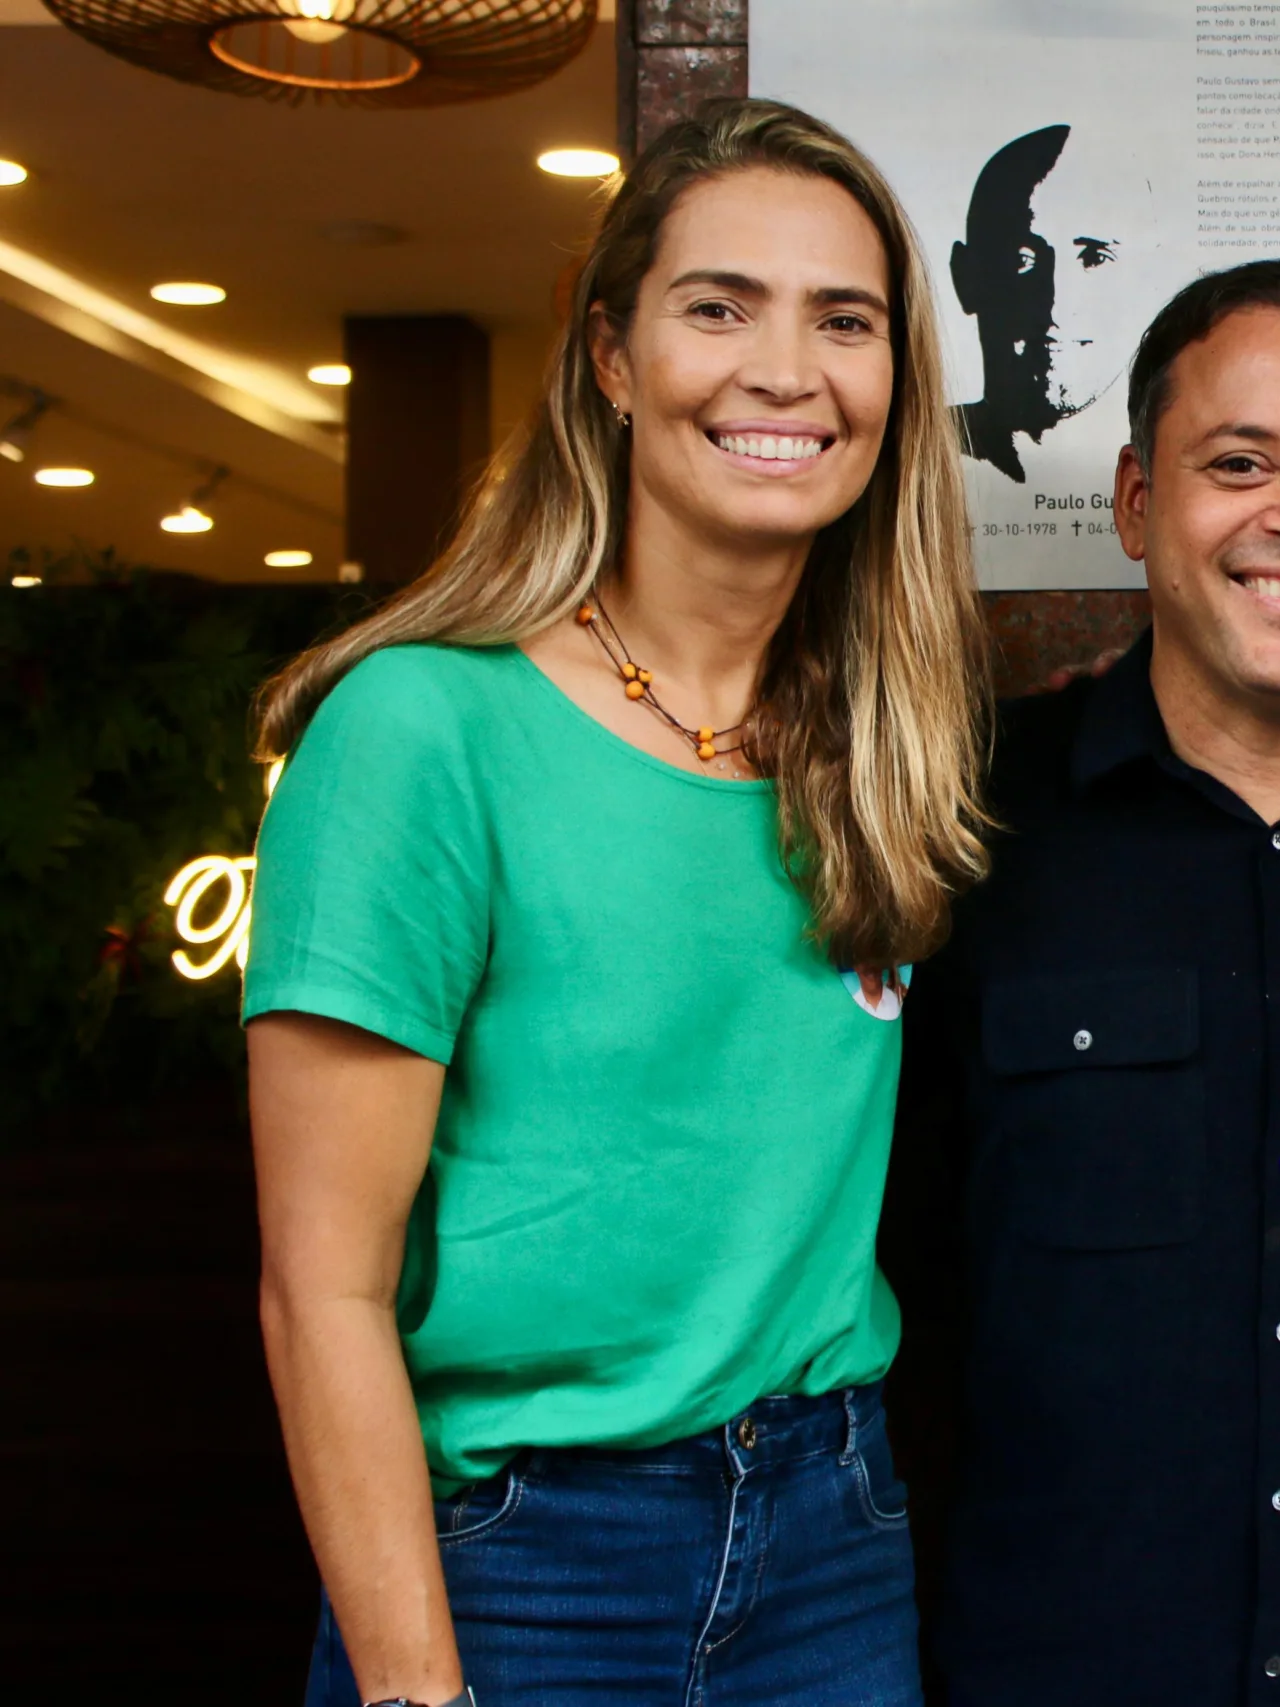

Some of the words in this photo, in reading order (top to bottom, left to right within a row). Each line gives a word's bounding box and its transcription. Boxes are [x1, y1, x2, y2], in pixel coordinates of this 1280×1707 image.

[1215, 17, 1234, 27] todo
[1196, 34, 1251, 44] personagem
[1197, 76, 1221, 86] Paulo
[1225, 76, 1259, 86] Gustavo
[1197, 179, 1220, 188] Além
[1237, 179, 1274, 190] espalhar
[1198, 208, 1218, 217] Mais
[1235, 210, 1250, 219] que
[1198, 223, 1220, 232] Além
[1034, 494, 1085, 510] Paulo
[983, 523, 1057, 536] 30-10-1978
